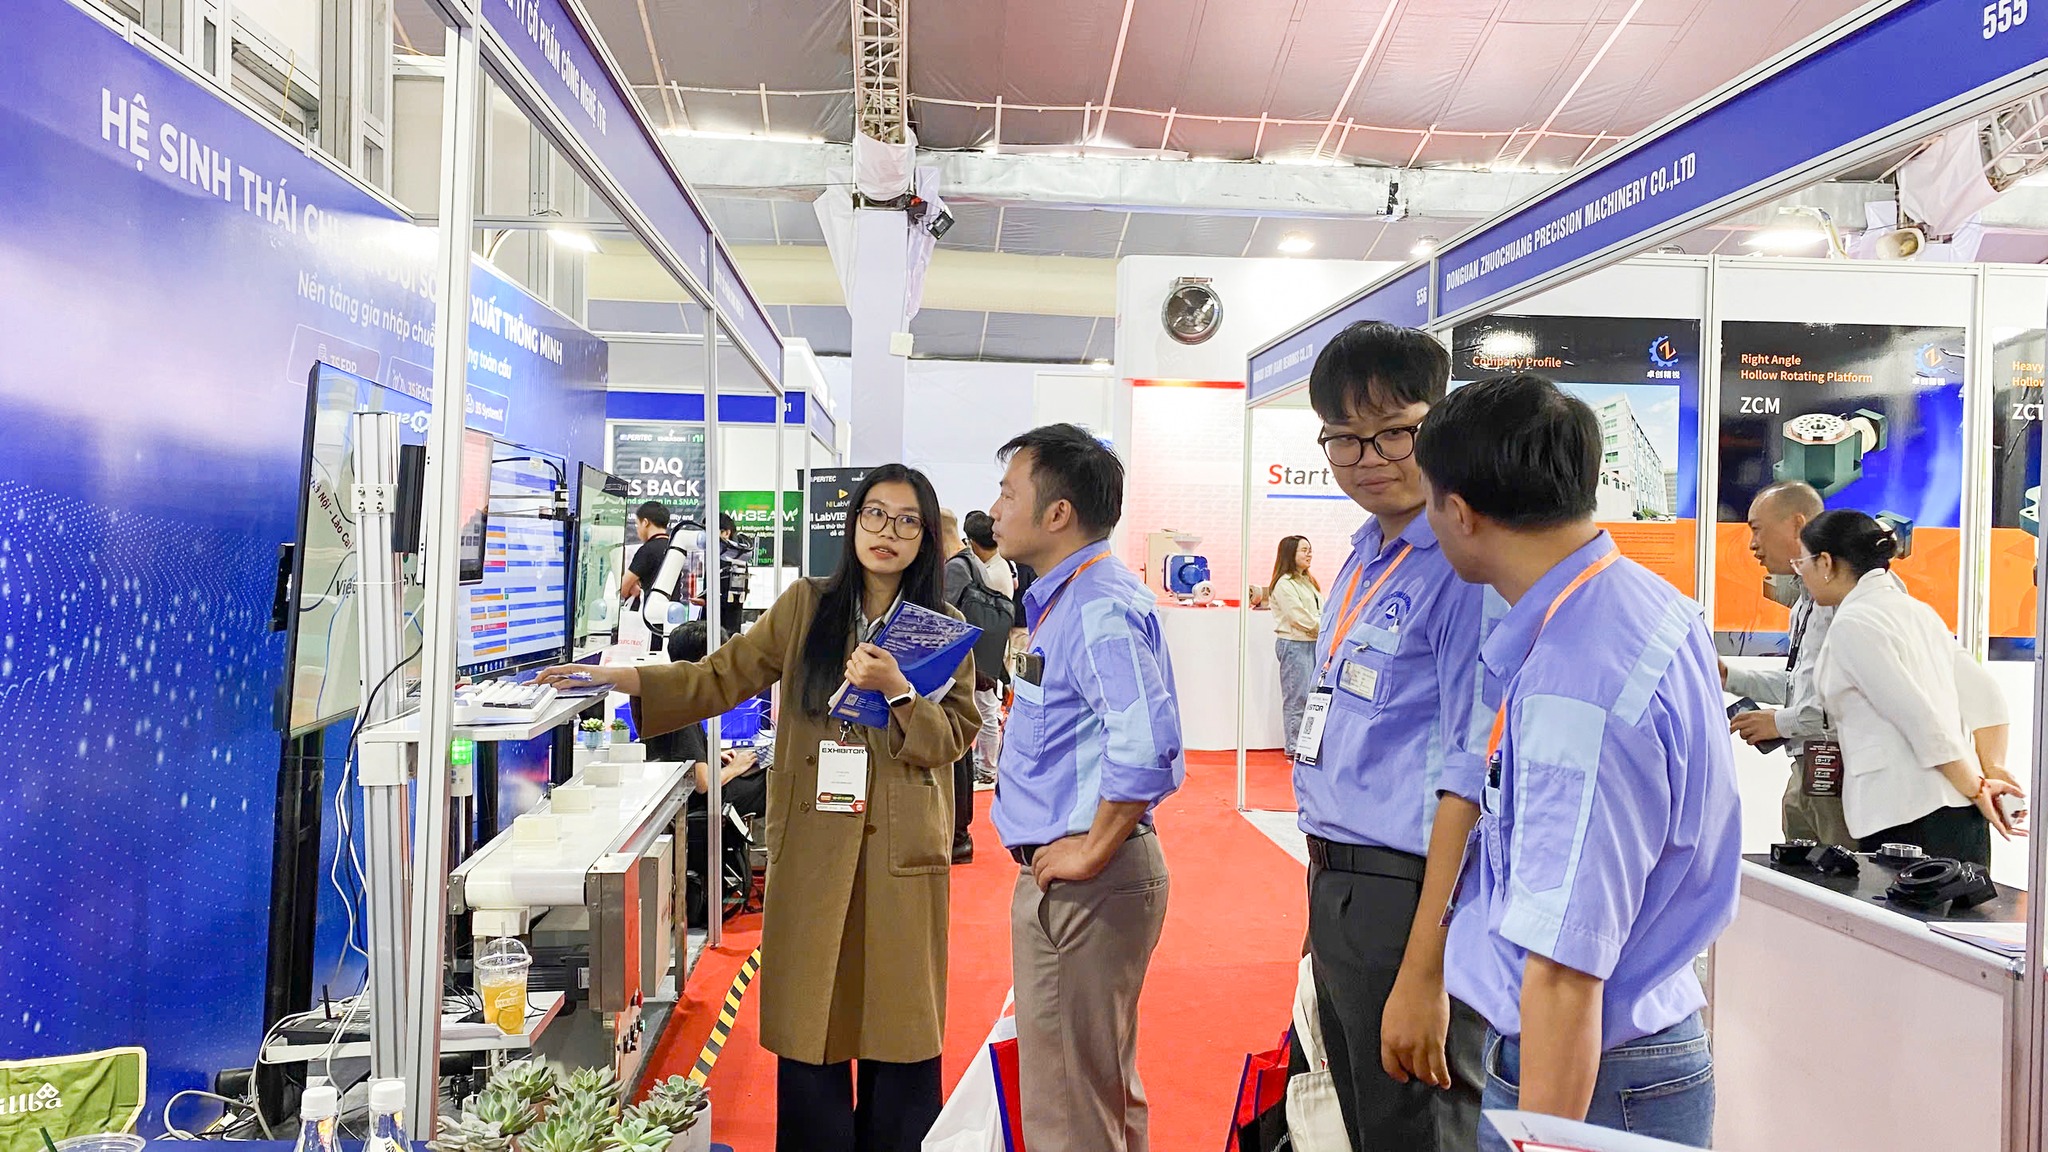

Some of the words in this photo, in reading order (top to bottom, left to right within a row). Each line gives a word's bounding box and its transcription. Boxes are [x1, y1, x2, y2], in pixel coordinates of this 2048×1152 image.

[1982, 0, 2028, 40] 555
[539, 18, 560, 74] PHẦN
[561, 50, 580, 100] CÔNG
[101, 87, 150, 172] HỆ
[159, 122, 231, 203] SINH
[238, 165, 297, 235] THÁI
[1446, 265, 1479, 291] DONGUAN
[1480, 236, 1532, 272] ZHUOCHUANG
[1533, 207, 1582, 251] PRECISION
[1584, 176, 1648, 228] MACHINERY
[1649, 152, 1696, 197] CO.,LTD
[298, 269, 325, 305] Nền
[329, 282, 359, 323] tảng
[361, 299, 381, 327] gia
[382, 307, 410, 343] nhập
[411, 320, 435, 348] chuỗ
[471, 294, 502, 336] XUẤT
[503, 312, 539, 354] THÔNG
[540, 332, 563, 366] MINH
[480, 350, 498, 375] toàn
[498, 357, 512, 380] cầu
[1472, 356, 1524, 370] Company
[1526, 356, 1562, 368] Profile
[1741, 353, 1769, 367] Right
[1771, 354, 1802, 367] Angle
[2012, 360, 2045, 373] Heavy
[1740, 369, 1778, 381] Hollow
[1780, 371, 1825, 384] Rotating
[1827, 371, 1873, 383] Platform
[1740, 396, 1781, 415] ZCM
[640, 457, 683, 478] DAQ
[646, 479, 700, 497] BACK
[318, 491, 332, 510] Nội
[330, 514, 343, 534] Lào
[341, 532, 355, 550] Cai
[682, 513, 694, 521] and
[814, 511, 847, 522] LabVIE
[822, 747, 865, 755] EXHIBITOR
